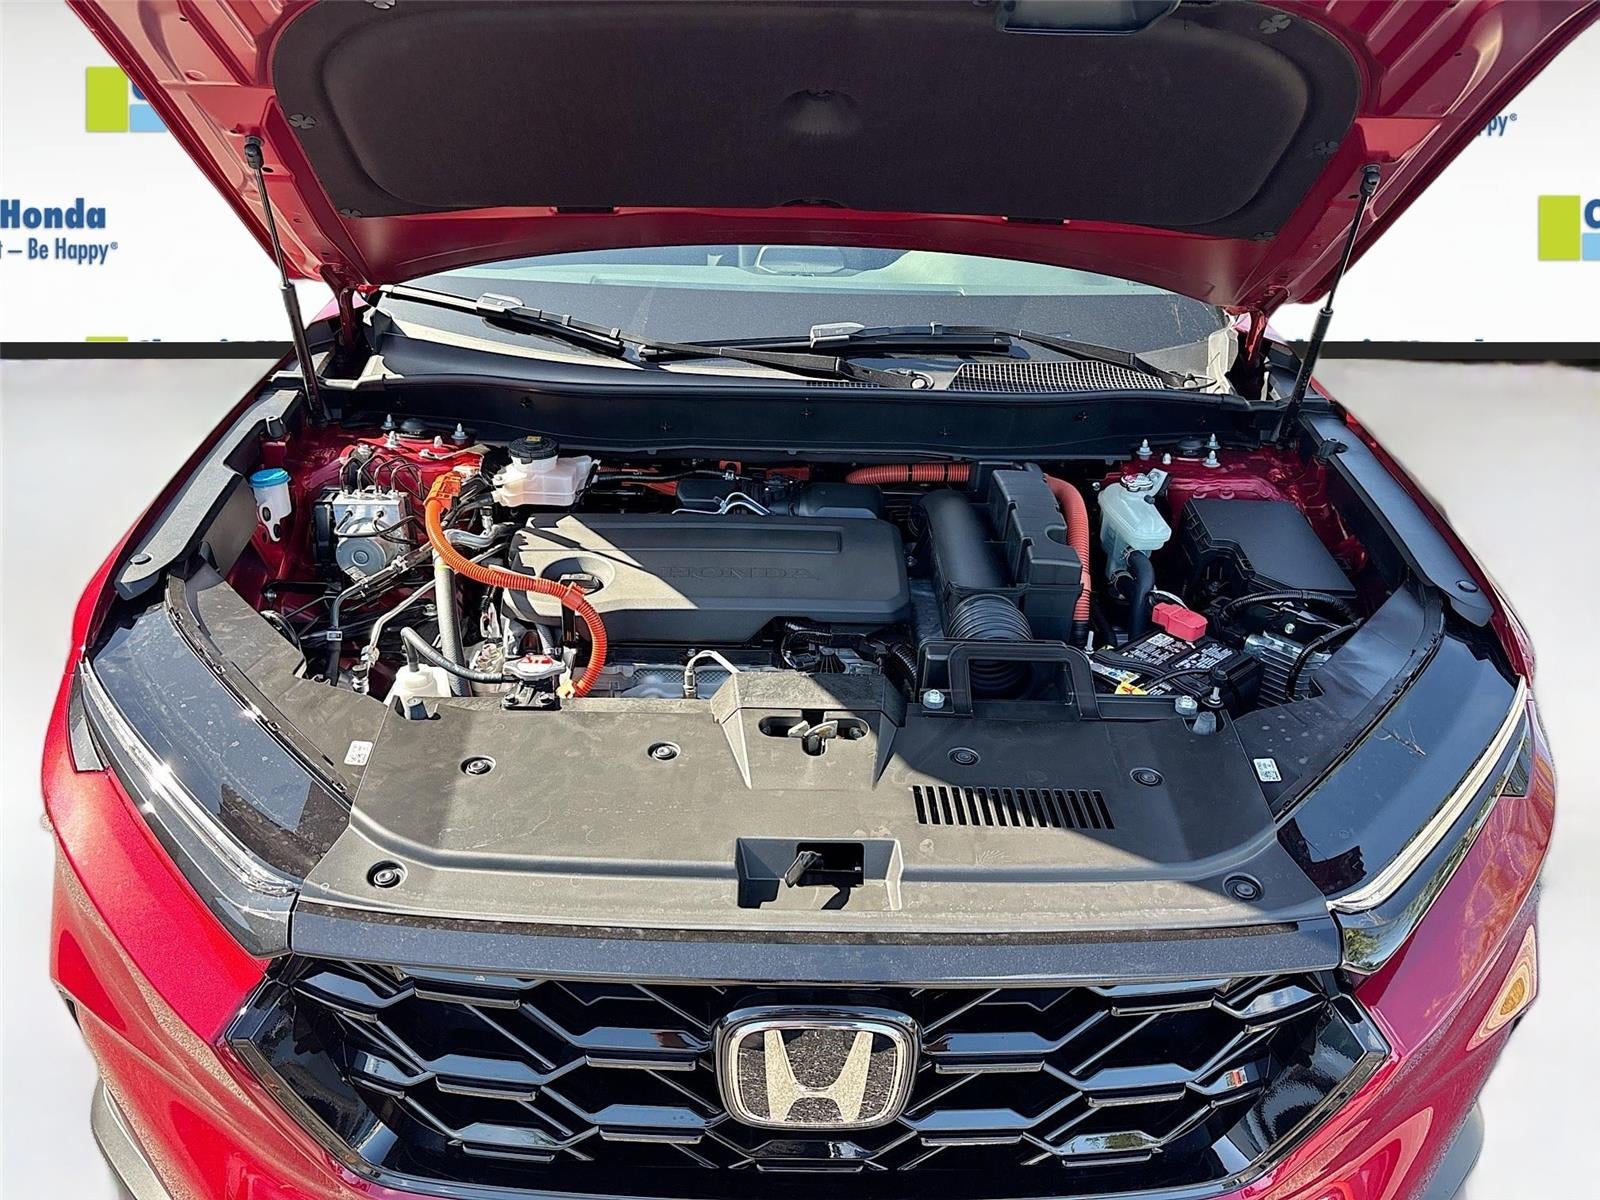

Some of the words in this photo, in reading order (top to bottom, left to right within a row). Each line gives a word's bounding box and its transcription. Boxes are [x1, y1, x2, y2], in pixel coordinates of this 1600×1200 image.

[0, 197, 106, 229] Honda
[28, 237, 49, 260] Be
[660, 565, 820, 580] HONDA
